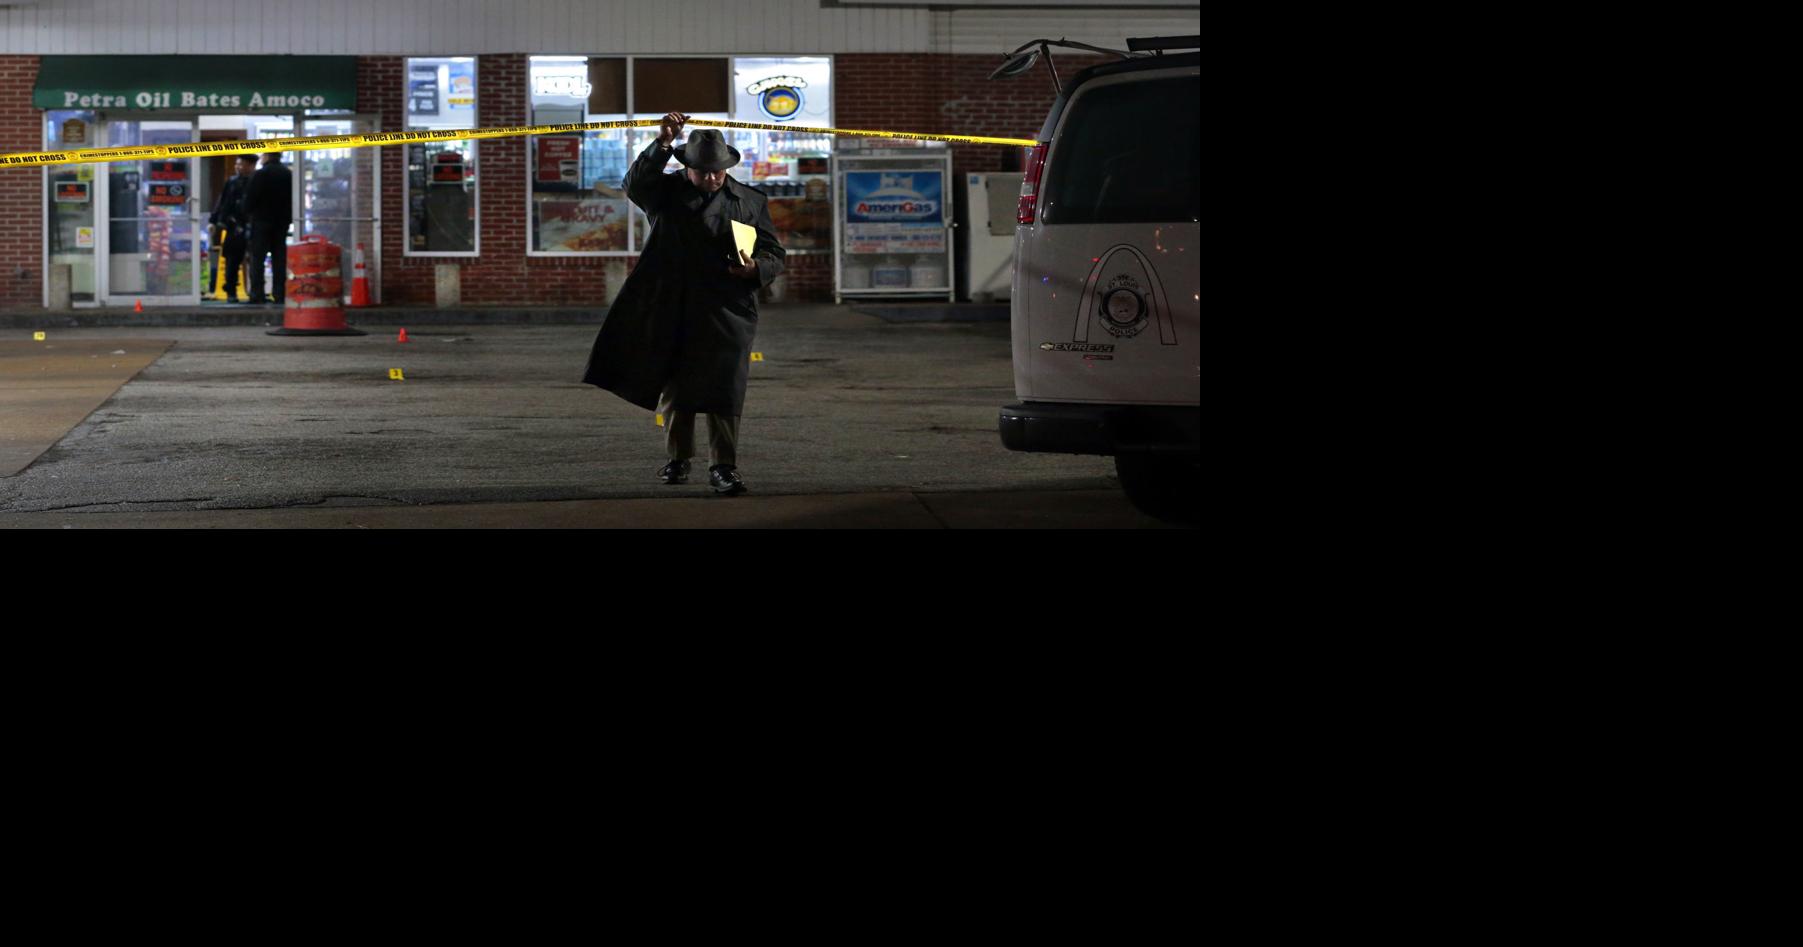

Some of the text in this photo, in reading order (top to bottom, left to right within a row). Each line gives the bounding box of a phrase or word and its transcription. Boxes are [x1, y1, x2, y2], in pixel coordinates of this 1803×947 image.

[64, 91, 325, 107] Petra Oil Bates Amoco
[550, 123, 574, 131] POLICE
[725, 121, 747, 129] POLICE
[748, 122, 761, 130] LINE
[363, 134, 388, 142] POLICE
[168, 145, 194, 154] POLICE
[22, 155, 38, 163] NOT
[856, 201, 933, 215] AmeriGas
[1054, 343, 1115, 352] EXPRESS
